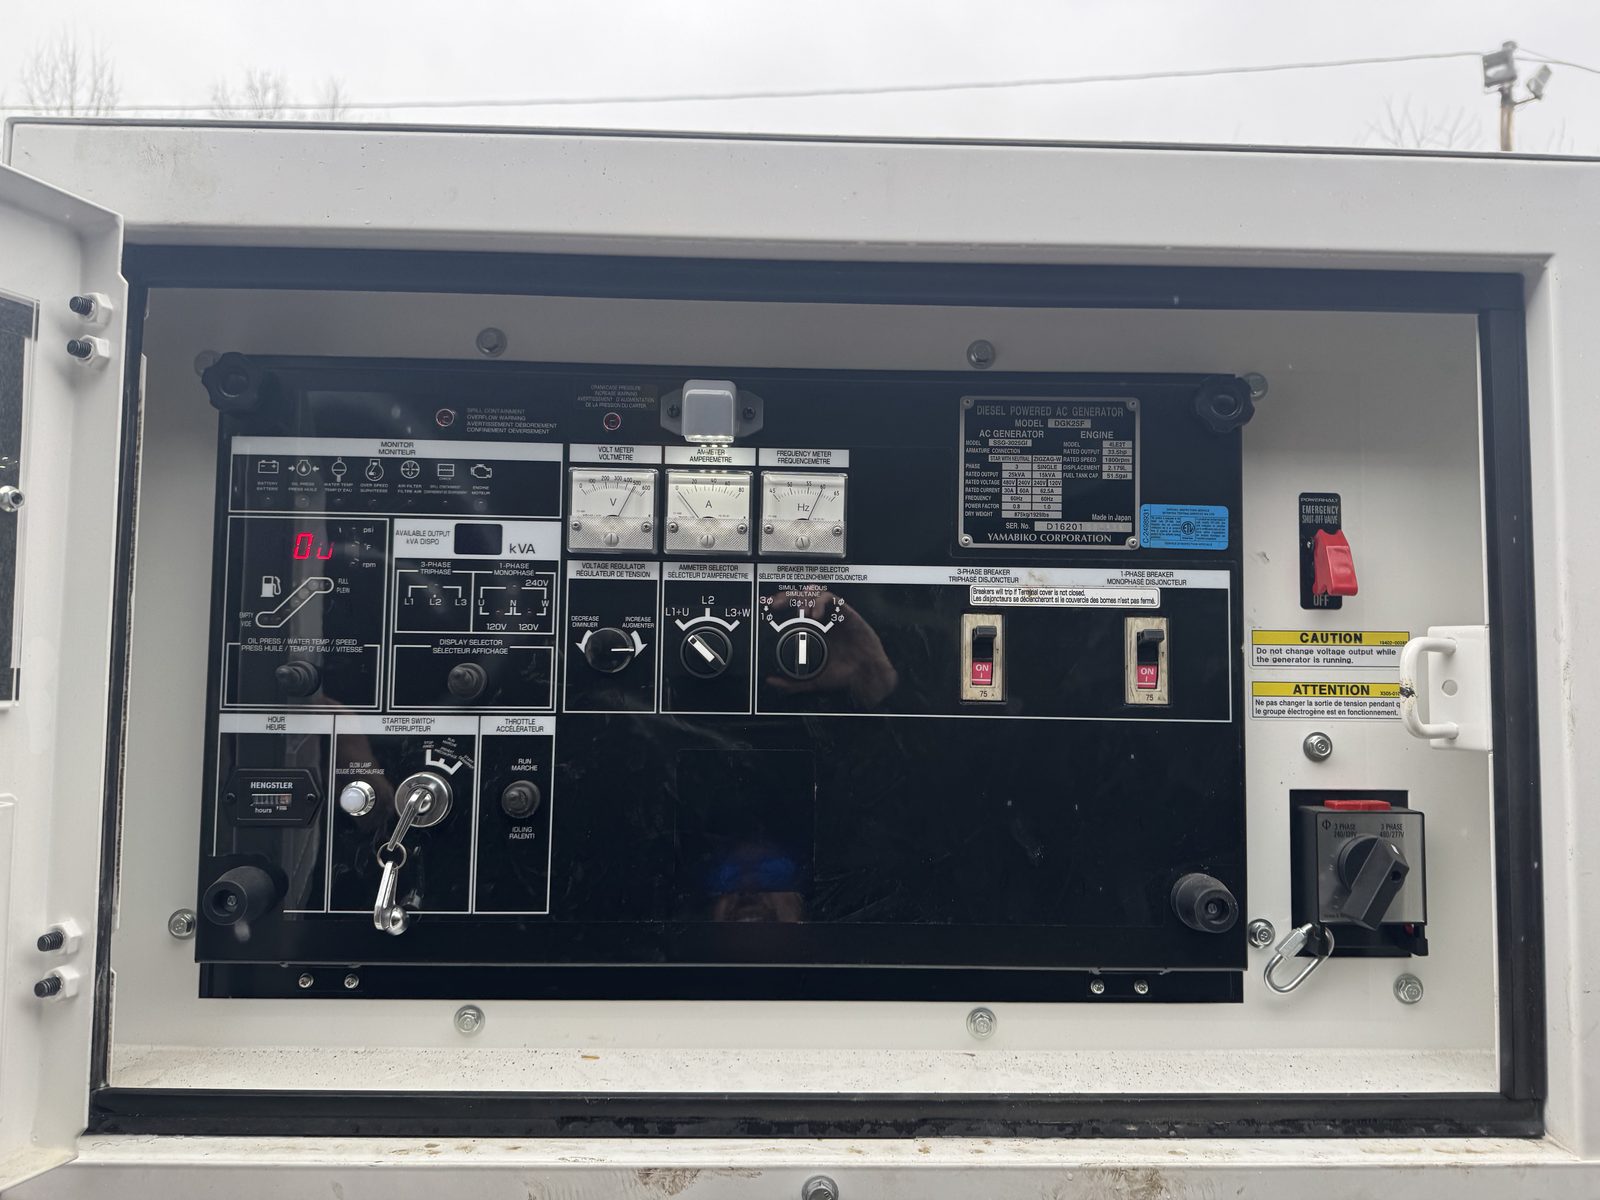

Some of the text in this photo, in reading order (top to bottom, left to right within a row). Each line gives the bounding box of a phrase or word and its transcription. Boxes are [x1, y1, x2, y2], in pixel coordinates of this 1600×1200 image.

[977, 405, 1124, 417] DIESEL POWERED AC GENERATOR
[1015, 419, 1044, 428] MODEL
[979, 429, 1044, 438] AC GENERATOR
[1080, 431, 1114, 439] ENGINE
[777, 450, 811, 458] FREQUENCY
[609, 498, 617, 506] V
[705, 500, 713, 508] A
[797, 503, 810, 512] Hz
[1302, 504, 1339, 514] EMERGENCY
[1114, 514, 1131, 522] Japan
[988, 533, 1112, 543] YAMABIKO CORPORATION
[509, 543, 536, 554] kVA
[582, 562, 609, 570] VOLTAGE
[983, 568, 1010, 576] BREAKER
[701, 596, 715, 605] L2
[1313, 595, 1329, 606] OFF
[665, 607, 689, 617] L1+U
[725, 608, 751, 617] L3+W
[486, 623, 539, 631] 120V 120V
[1299, 632, 1363, 644] CAUTION
[1256, 647, 1267, 655] Do
[1285, 648, 1314, 656] change
[1317, 648, 1346, 656] voltage
[1376, 648, 1396, 656] while
[1322, 656, 1354, 664] running.
[975, 664, 989, 672] ON
[1140, 667, 1154, 675] ON
[1293, 684, 1370, 695] ATTENTION
[979, 690, 988, 698] 75
[1145, 693, 1154, 701] 75
[1347, 708, 1399, 716] fonctionnement.
[266, 723, 286, 731] HEURE
[1385, 823, 1403, 831] PHASE
